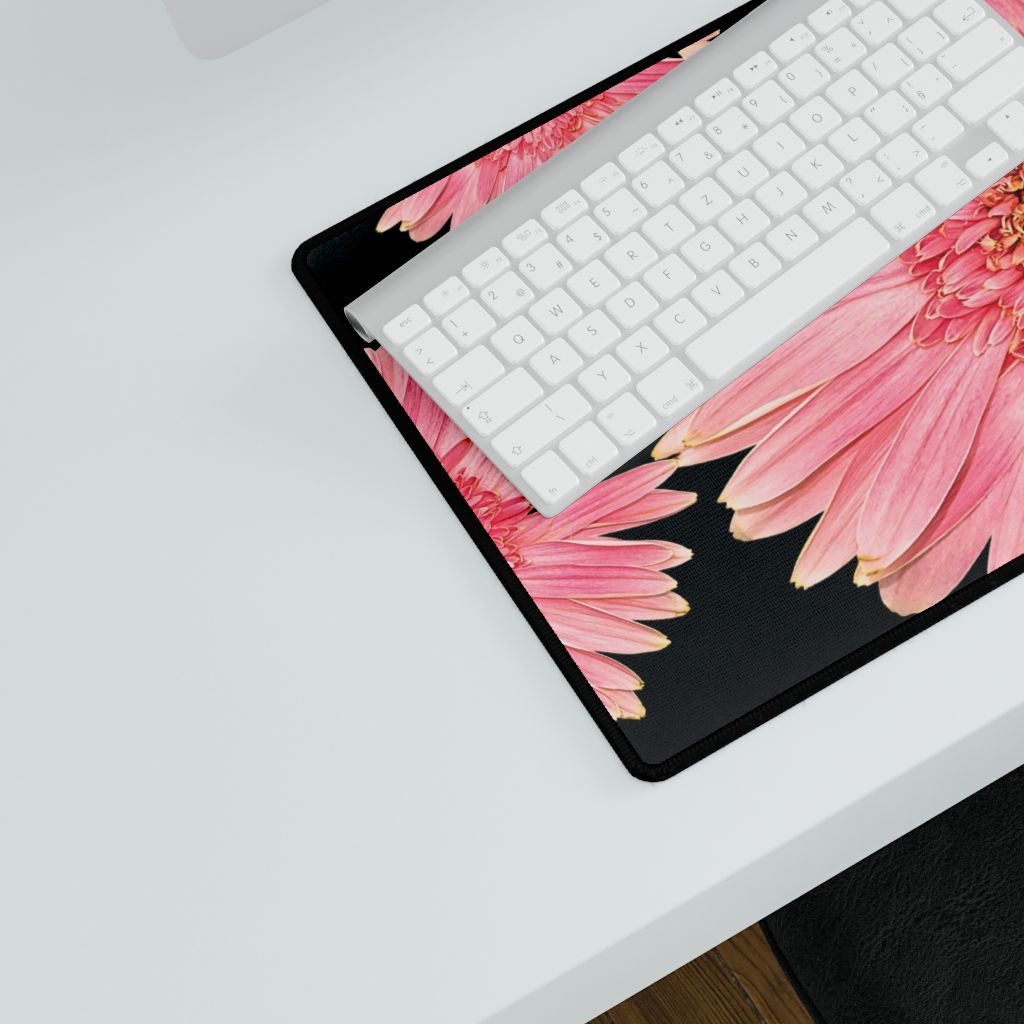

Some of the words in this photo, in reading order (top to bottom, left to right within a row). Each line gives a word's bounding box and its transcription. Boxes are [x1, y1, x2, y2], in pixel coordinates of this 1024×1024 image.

[847, 86, 856, 97] P
[749, 99, 758, 108] 9
[712, 126, 722, 135] 8
[847, 134, 858, 142] L
[675, 152, 684, 162] 7
[810, 159, 822, 170] K
[737, 166, 750, 178] U
[640, 180, 648, 189] 6
[776, 186, 784, 197] J
[701, 194, 713, 206] Z
[601, 207, 611, 217] 5
[821, 201, 836, 215] M
[735, 213, 749, 225] H
[663, 222, 674, 232] T
[566, 234, 574, 243] 4
[785, 229, 798, 241] N
[699, 241, 711, 252] G
[626, 250, 639, 261] R
[526, 263, 536, 272] 3
[748, 258, 760, 269] B
[662, 269, 671, 280] F
[589, 278, 600, 288] E
[710, 285, 721, 295] V
[488, 291, 498, 301] 2
[623, 297, 636, 308] D
[549, 304, 563, 317] W
[674, 313, 686, 324] C
[586, 326, 597, 336] S
[513, 334, 526, 345] Q
[635, 341, 649, 353] X
[550, 354, 561, 365] A
[596, 370, 607, 380] Y
